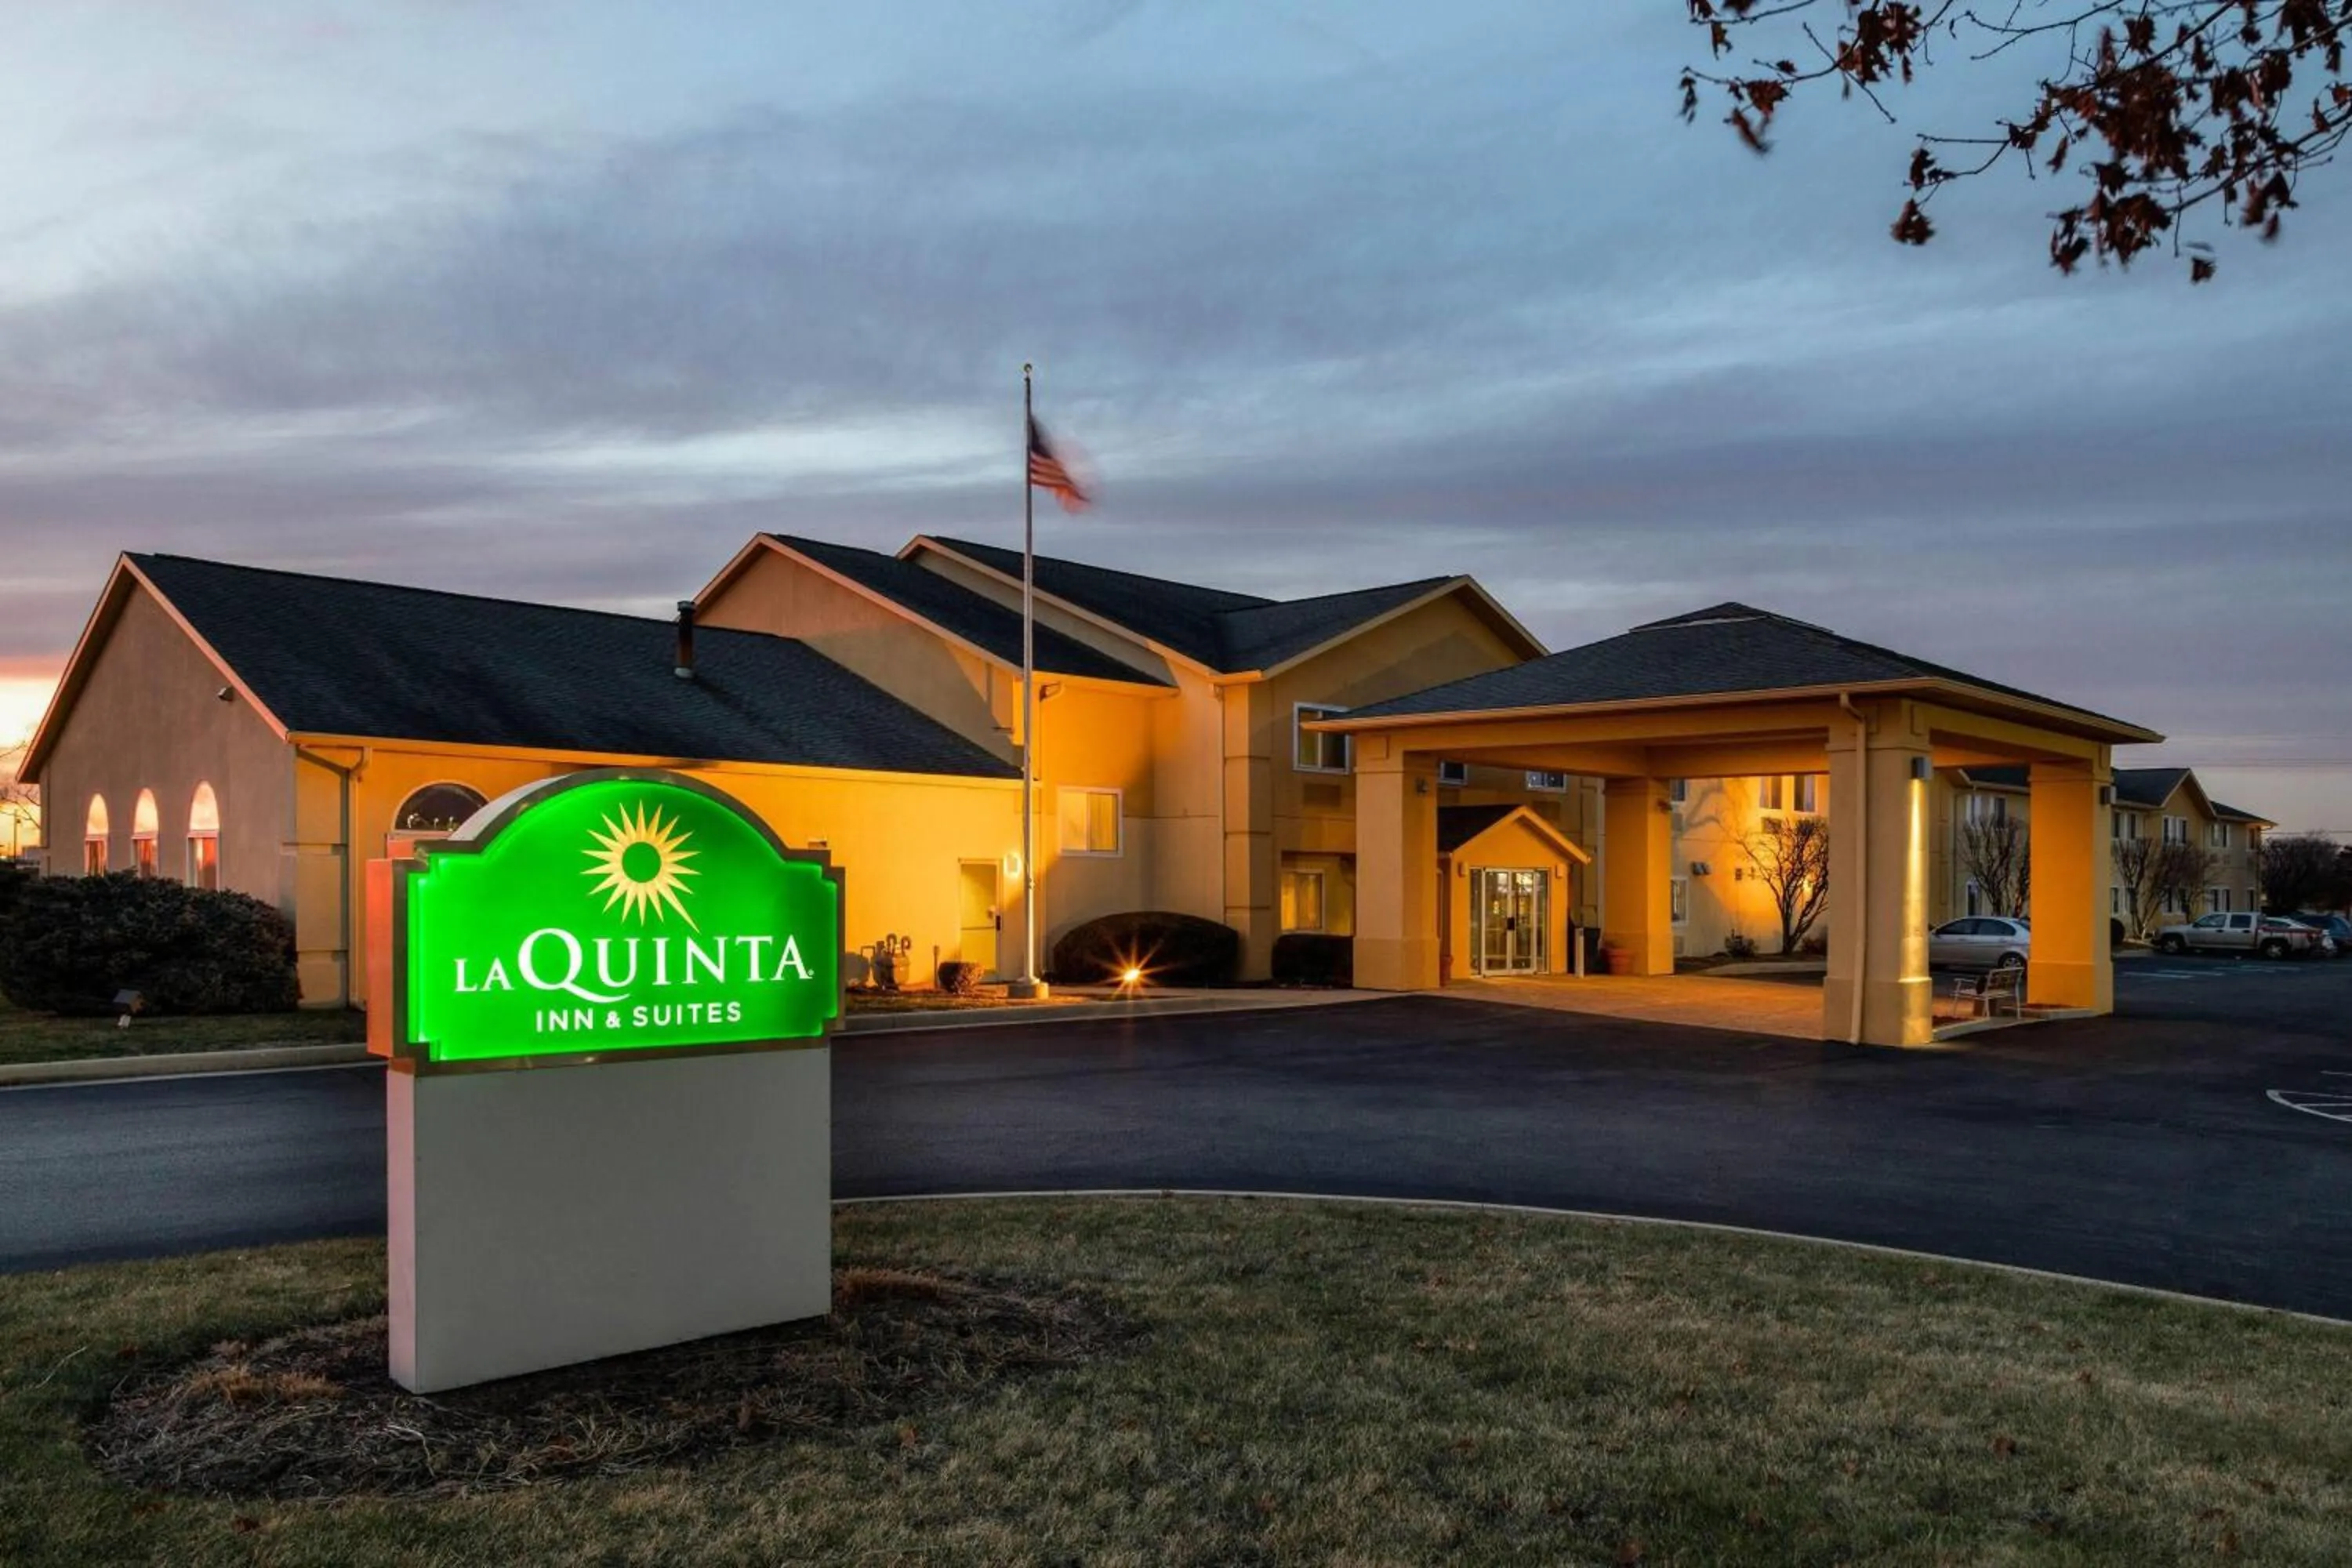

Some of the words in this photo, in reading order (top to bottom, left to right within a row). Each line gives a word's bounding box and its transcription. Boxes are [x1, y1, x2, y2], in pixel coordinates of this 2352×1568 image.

[455, 957, 514, 993] LA
[517, 927, 813, 1004] QUINTA
[536, 1009, 594, 1033] INN
[604, 1011, 622, 1029] &
[633, 1001, 742, 1028] SUITES
